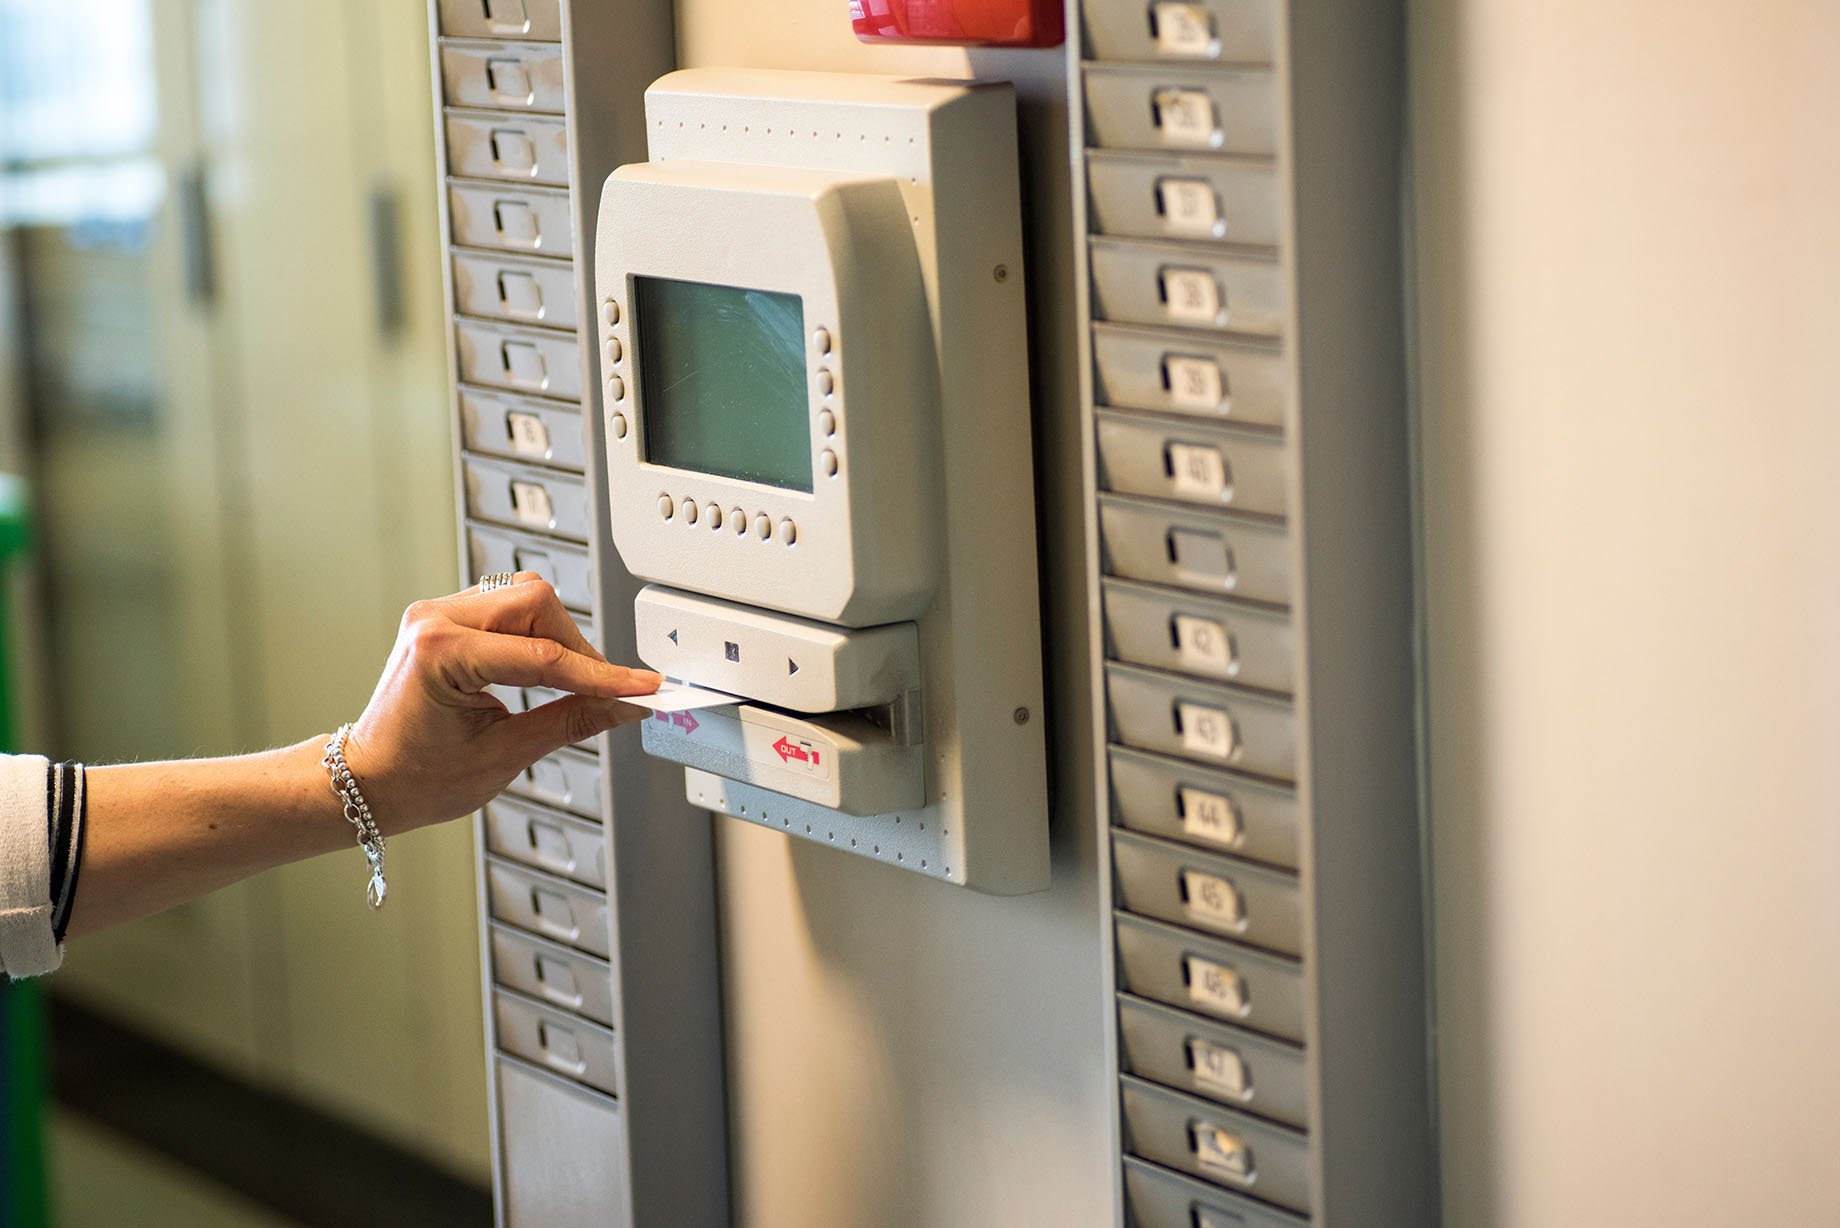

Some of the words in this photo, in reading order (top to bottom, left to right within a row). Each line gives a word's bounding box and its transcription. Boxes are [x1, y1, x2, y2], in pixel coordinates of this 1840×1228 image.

[1192, 626, 1212, 656] 42
[780, 744, 797, 756] OUT
[1198, 801, 1221, 828] 44
[1202, 882, 1223, 911] 45
